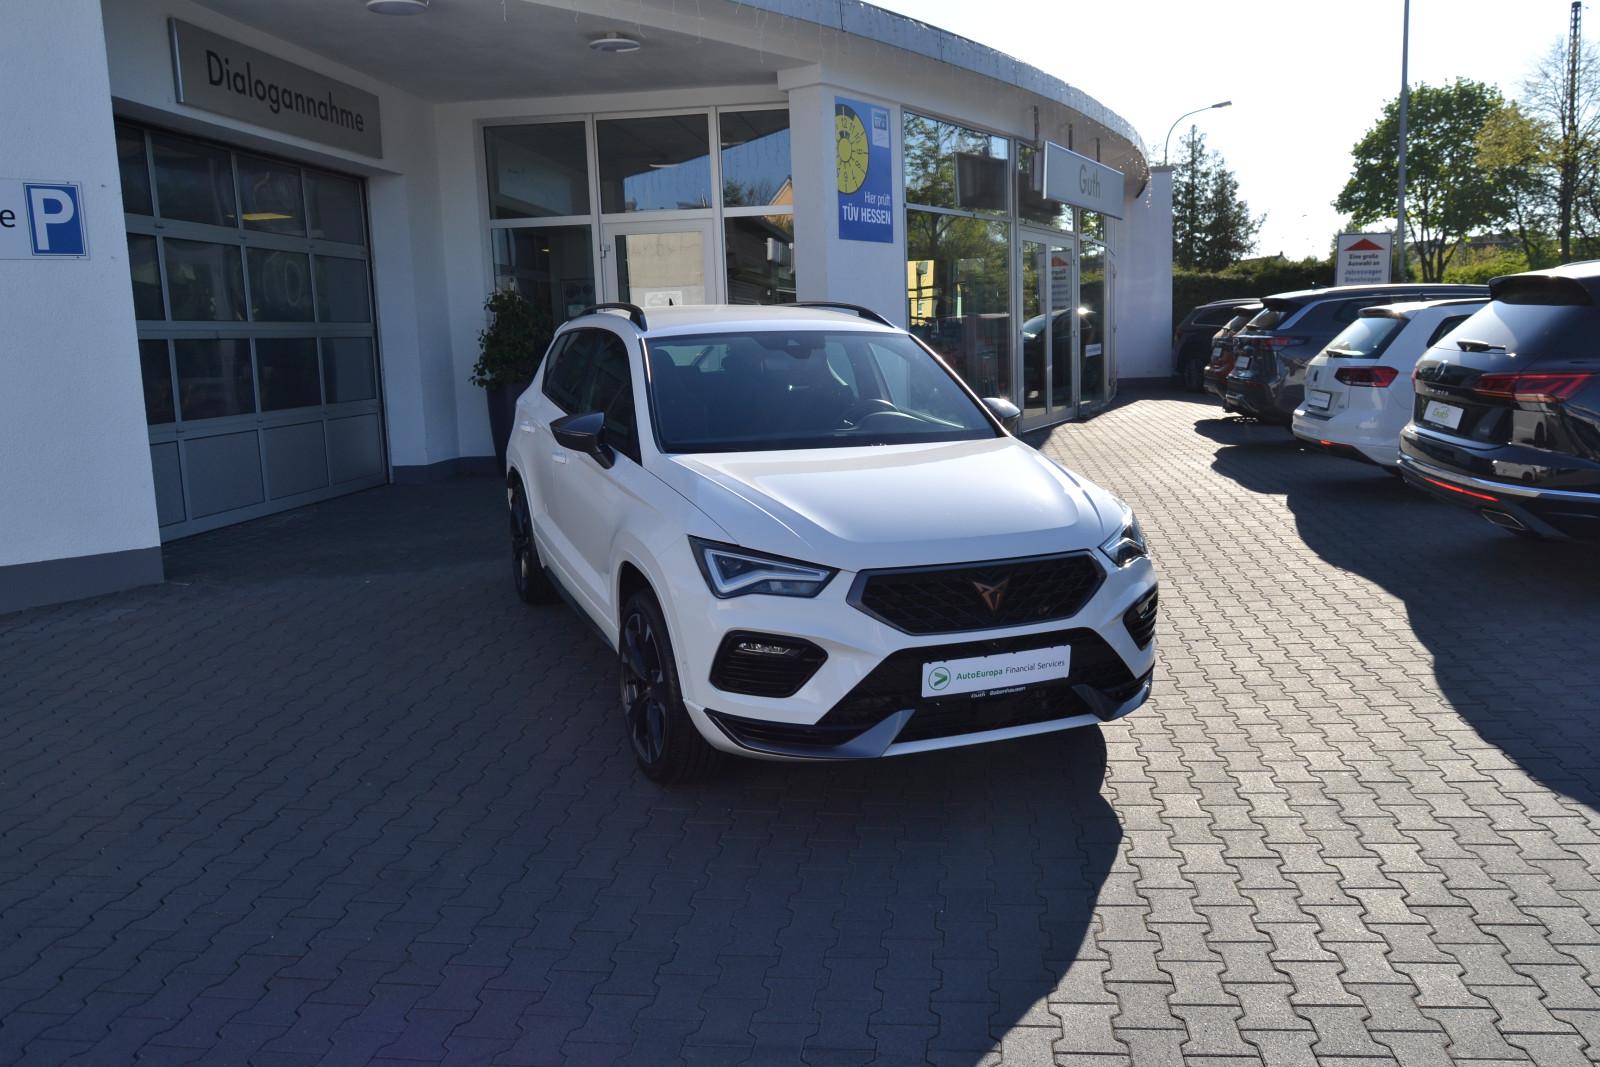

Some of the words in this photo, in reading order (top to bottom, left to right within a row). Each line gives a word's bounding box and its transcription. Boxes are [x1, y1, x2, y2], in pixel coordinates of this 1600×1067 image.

[206, 49, 364, 132] Dialogannahme
[1080, 164, 1101, 200] Guth
[30, 187, 75, 251] P
[842, 202, 859, 222] TÜV
[860, 207, 891, 225] HESSEN
[956, 668, 1003, 681] AutoEuropa
[1005, 663, 1036, 675] Financial
[1037, 659, 1065, 670] Services
